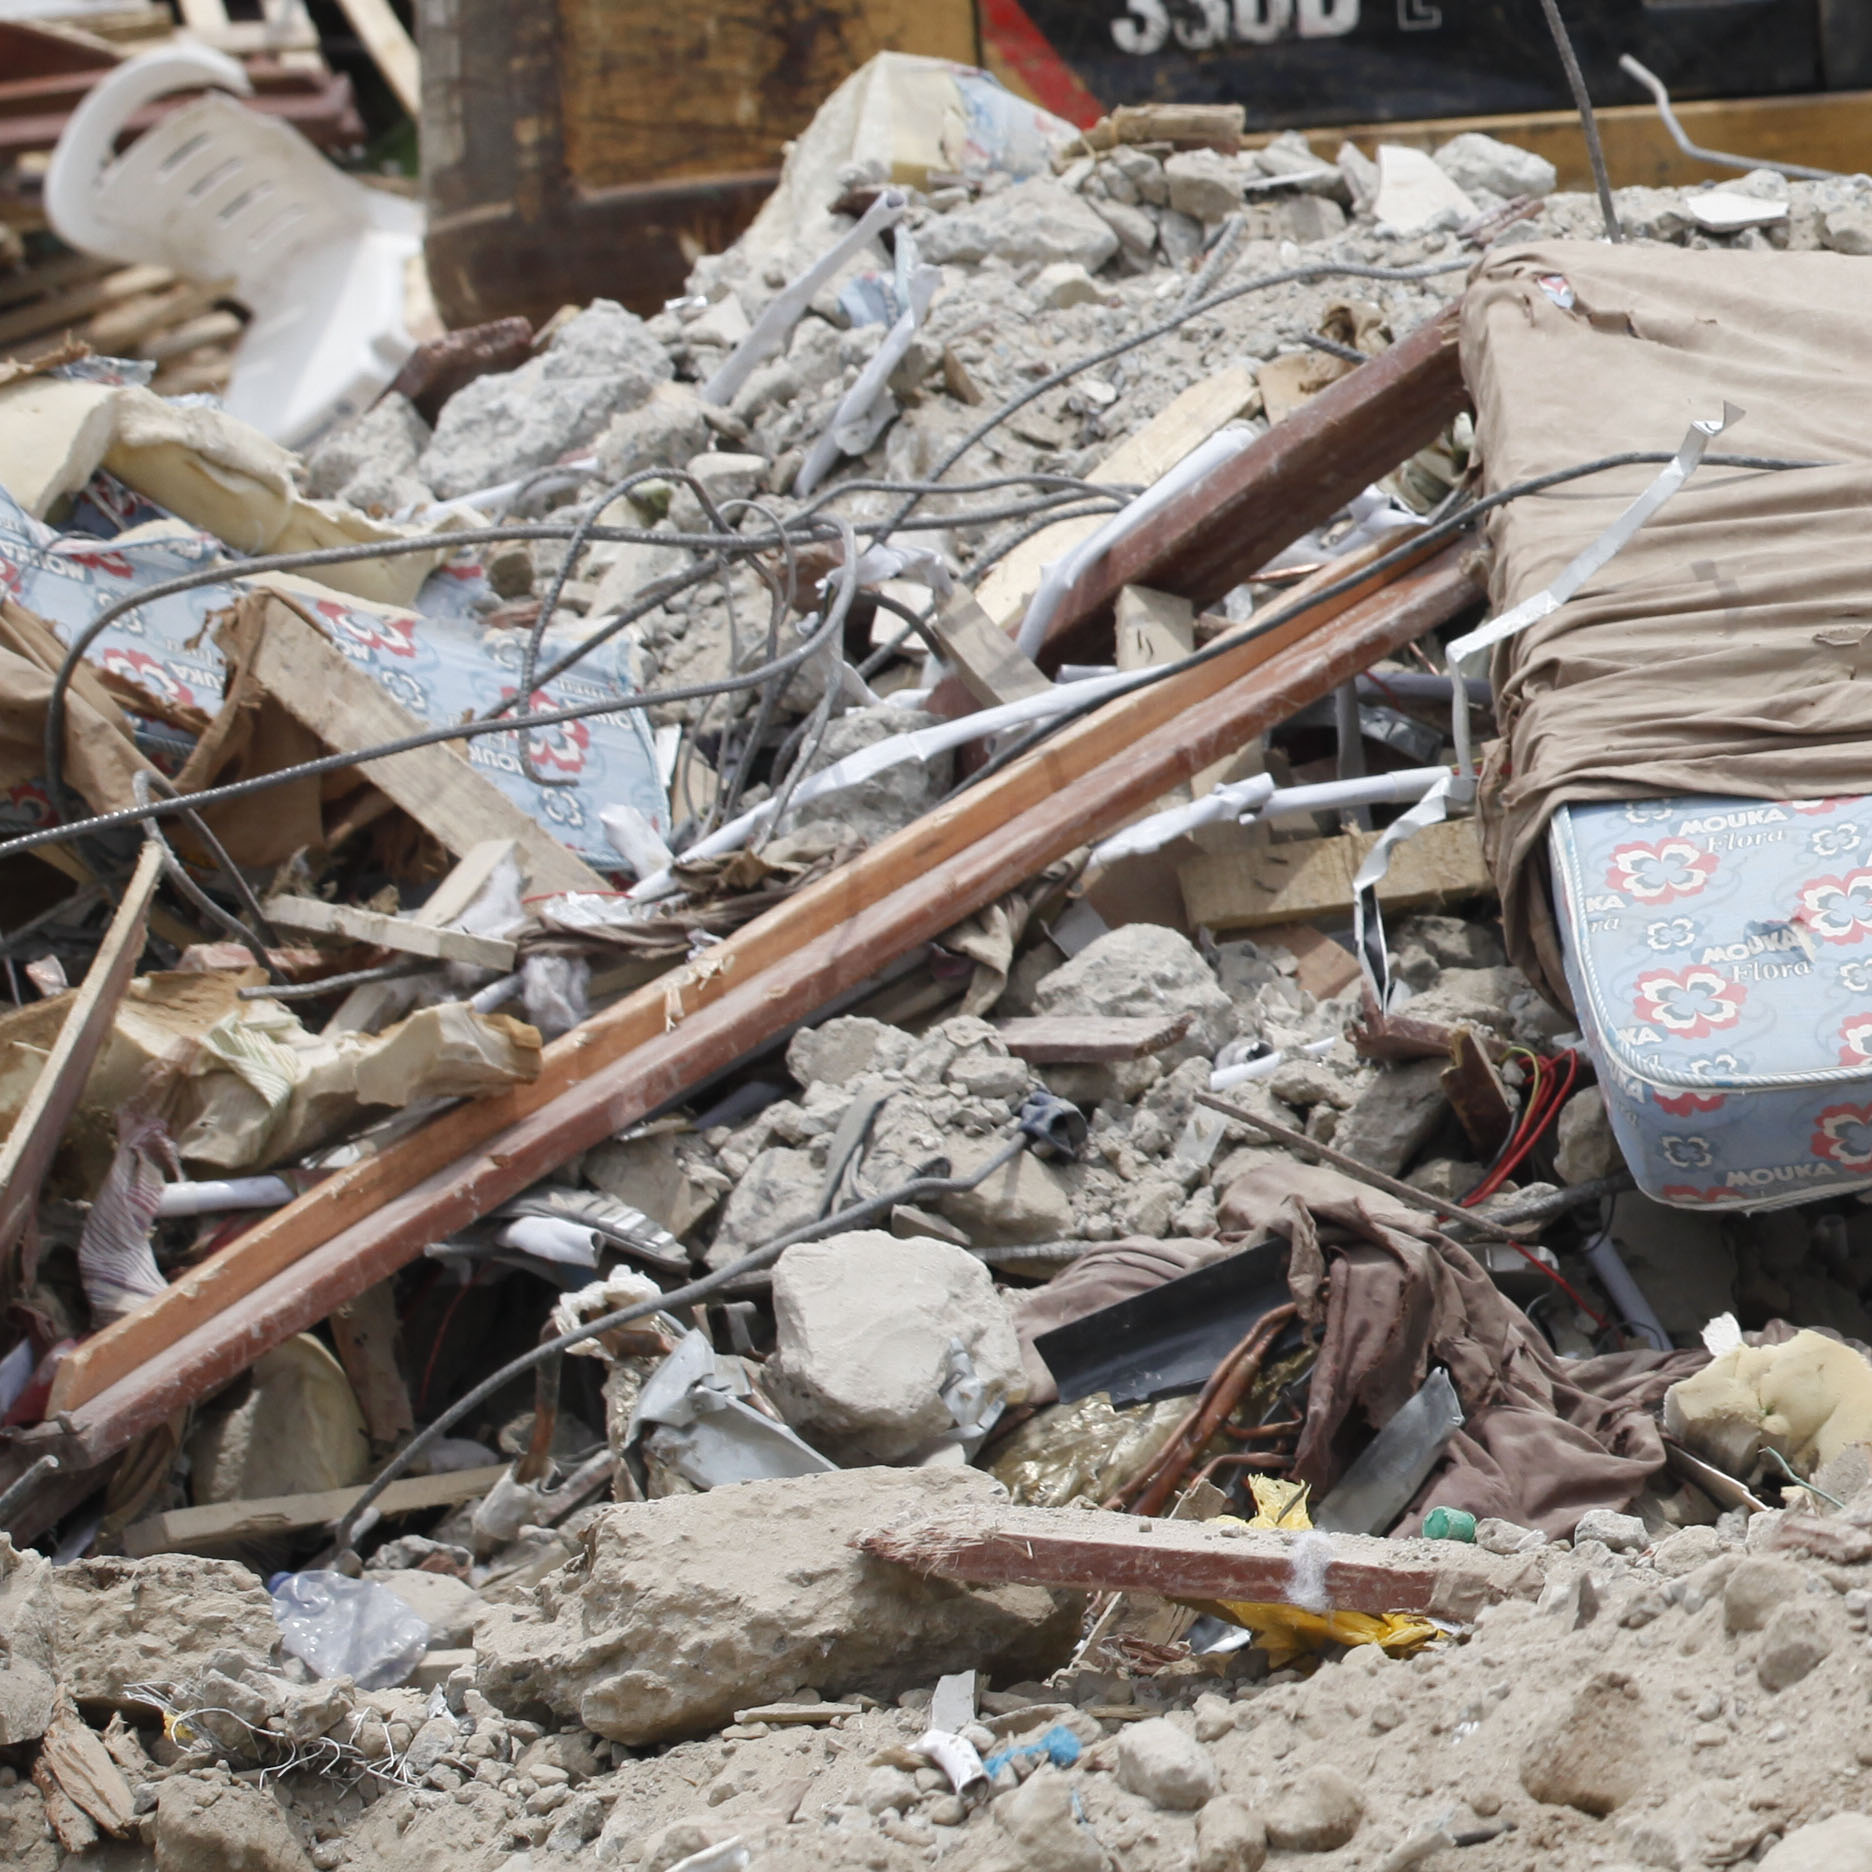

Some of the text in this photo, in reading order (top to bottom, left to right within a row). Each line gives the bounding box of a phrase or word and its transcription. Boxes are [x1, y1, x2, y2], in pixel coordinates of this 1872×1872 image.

[1677, 808, 1790, 837] MOUKA
[1706, 830, 1786, 855] Flora
[1730, 960, 1813, 984] Flora
[1725, 1162, 1837, 1188] MOUKA
